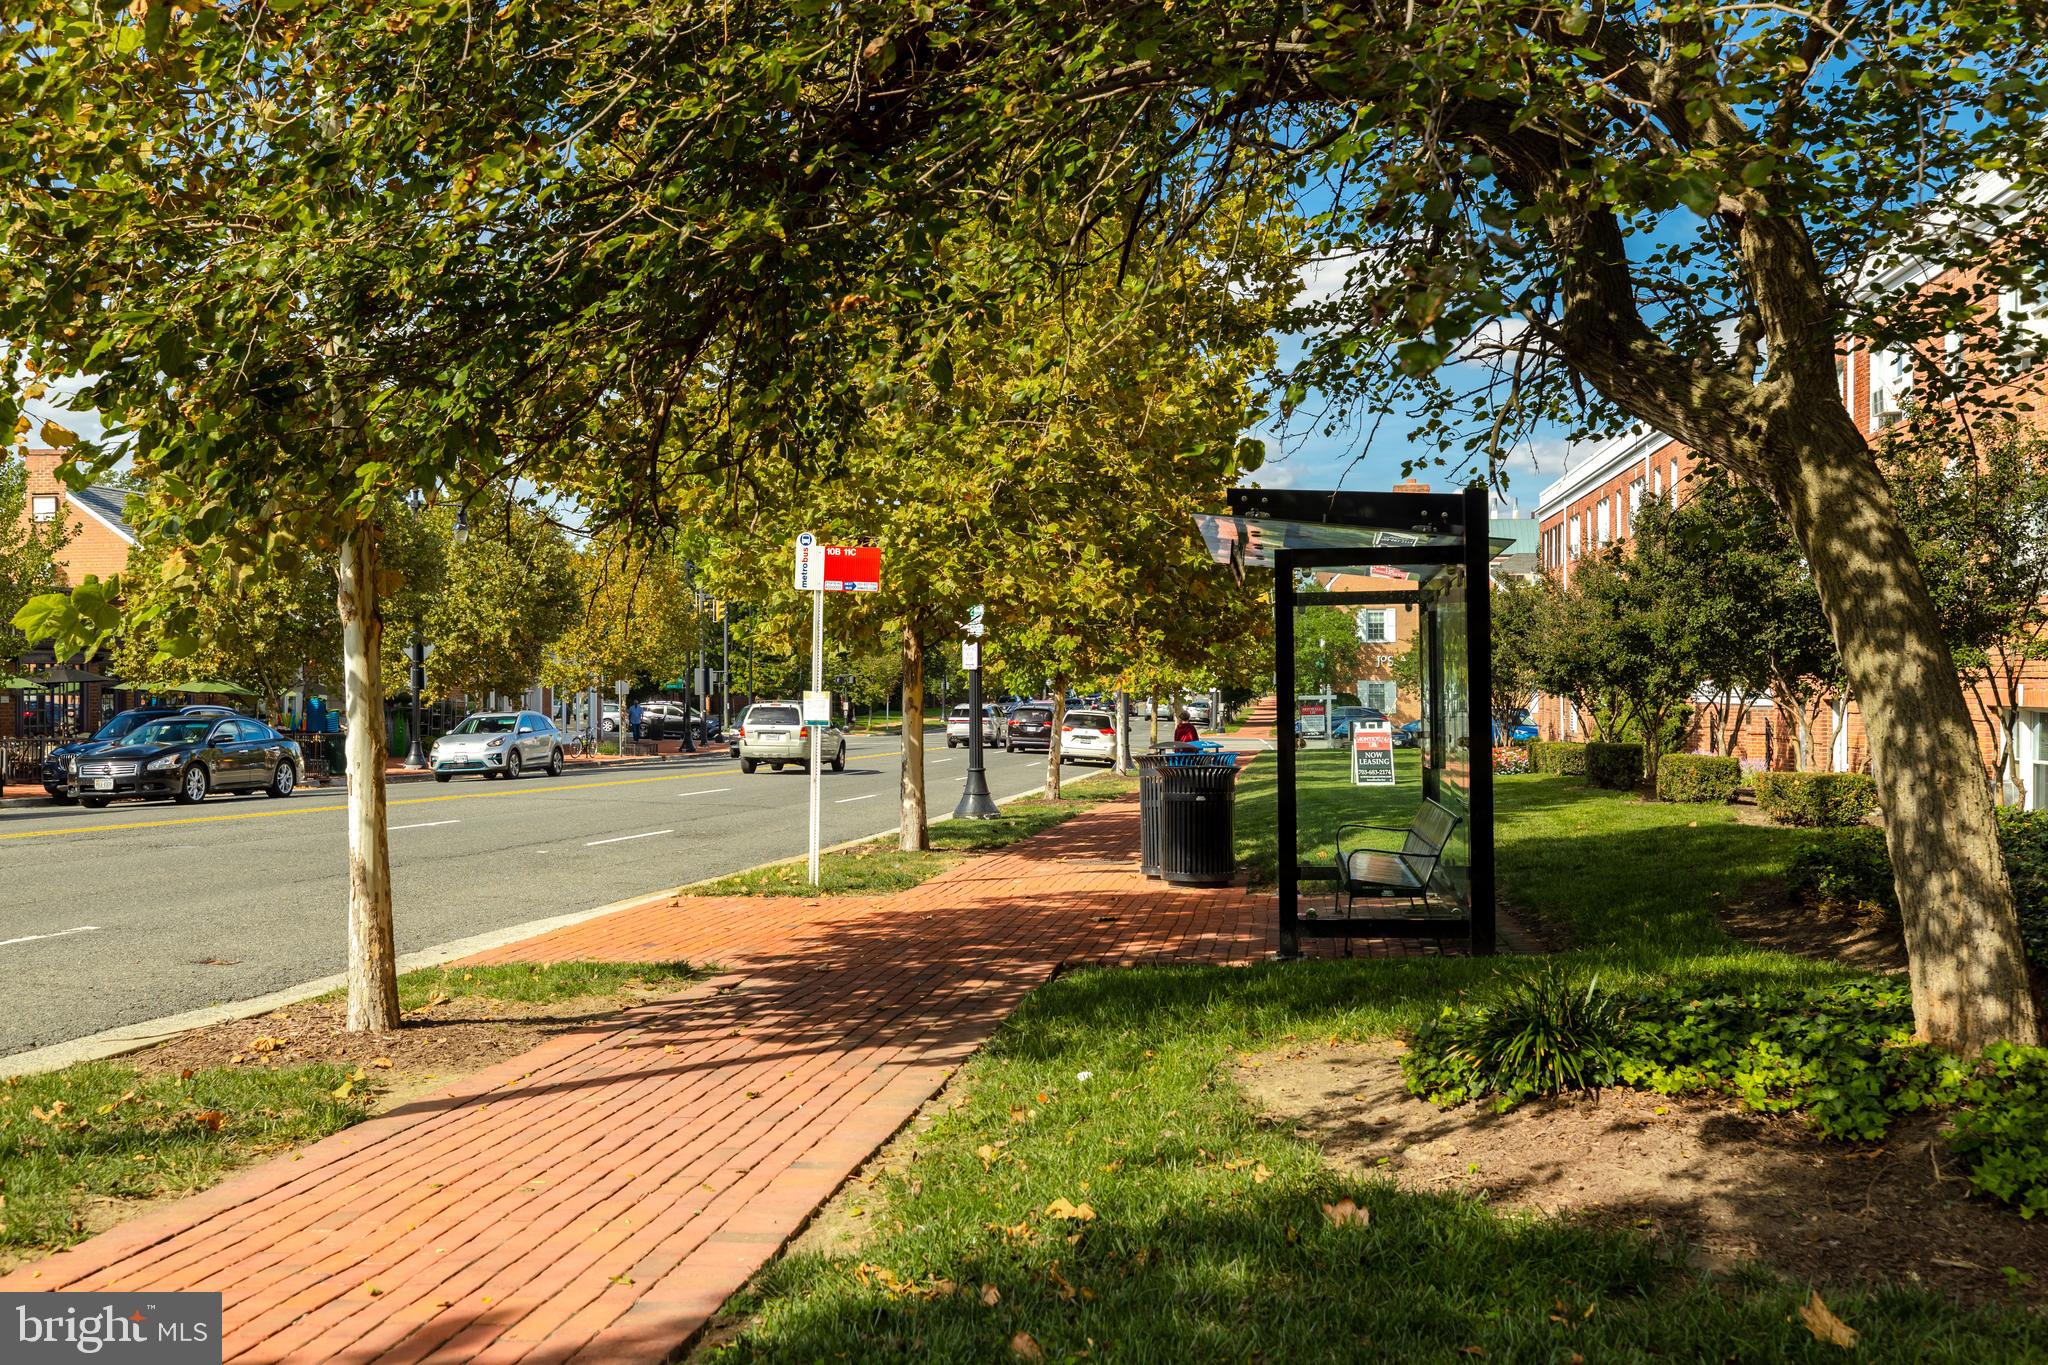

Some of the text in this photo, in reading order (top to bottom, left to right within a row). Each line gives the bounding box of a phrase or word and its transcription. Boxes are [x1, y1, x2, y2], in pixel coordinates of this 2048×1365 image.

[826, 547, 857, 556] 10B 11C
[801, 547, 809, 588] metrobus
